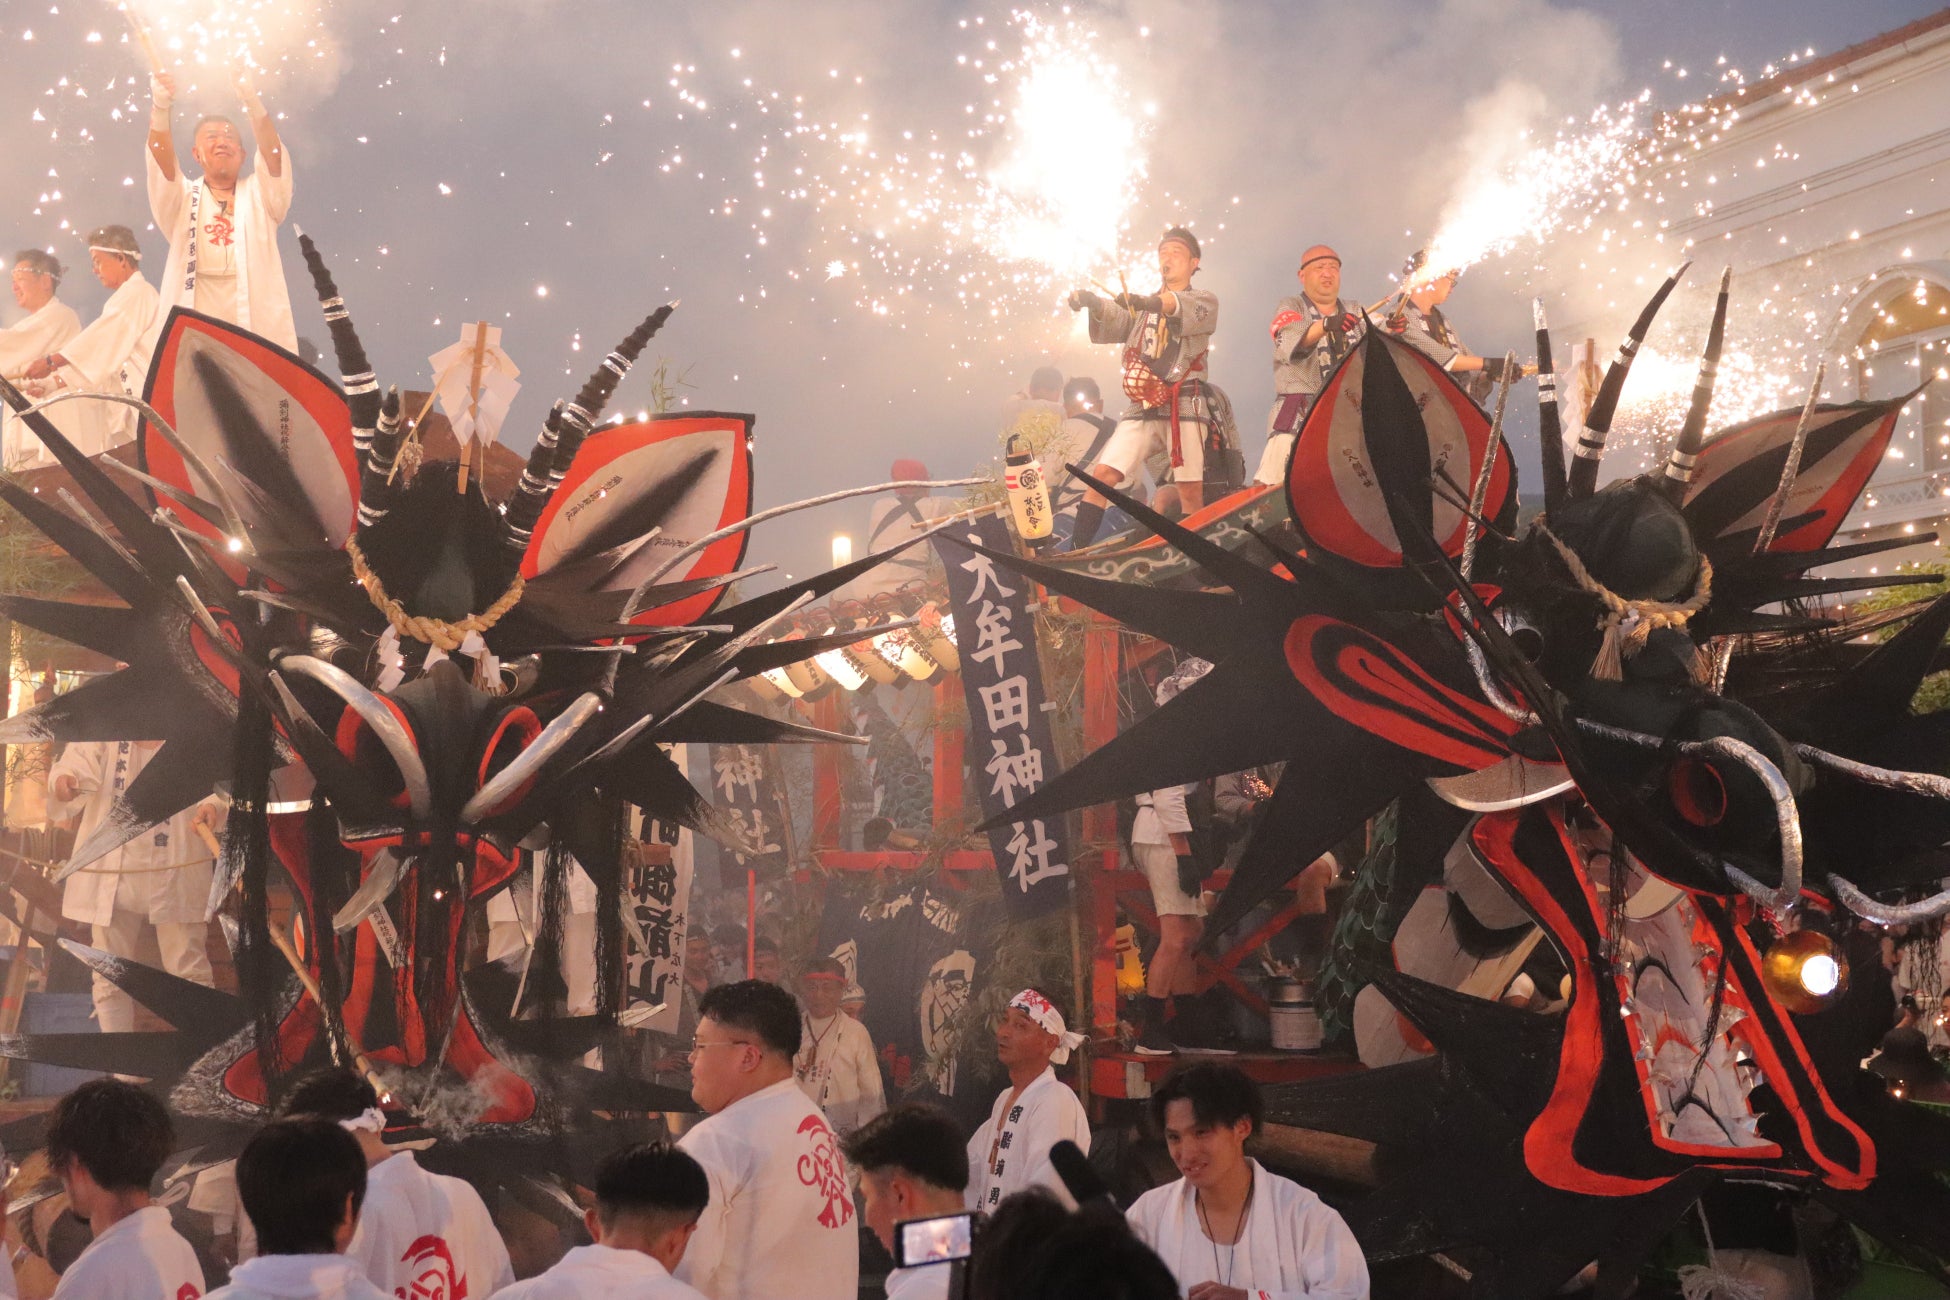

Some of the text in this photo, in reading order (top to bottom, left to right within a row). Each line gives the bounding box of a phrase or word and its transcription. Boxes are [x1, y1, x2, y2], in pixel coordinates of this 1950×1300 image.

[960, 534, 1069, 893] 大牟田神社
